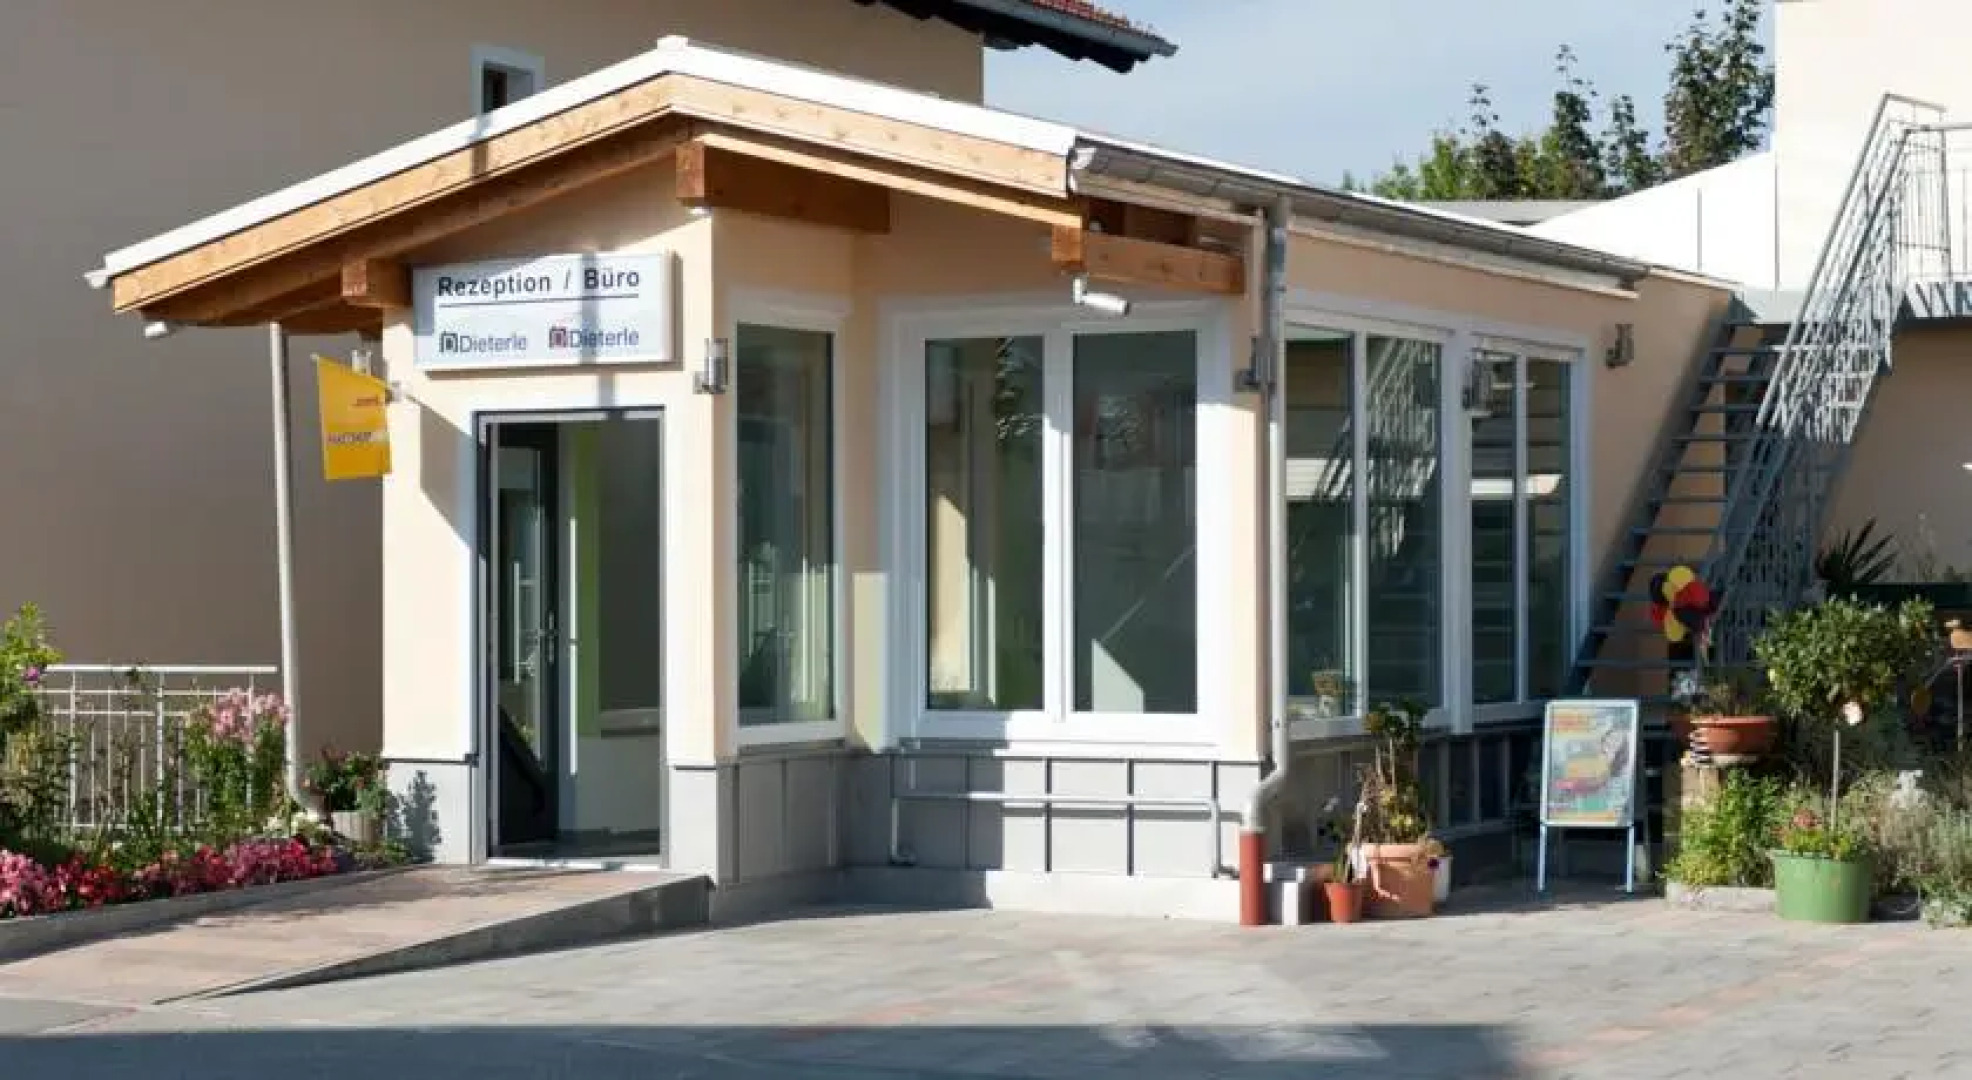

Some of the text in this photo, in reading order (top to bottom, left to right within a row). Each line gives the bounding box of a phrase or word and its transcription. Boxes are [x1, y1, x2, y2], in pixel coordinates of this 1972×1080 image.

[438, 266, 640, 299] Rezeption / Büro
[459, 332, 527, 353] Dieterle
[569, 327, 640, 349] Dieterle
